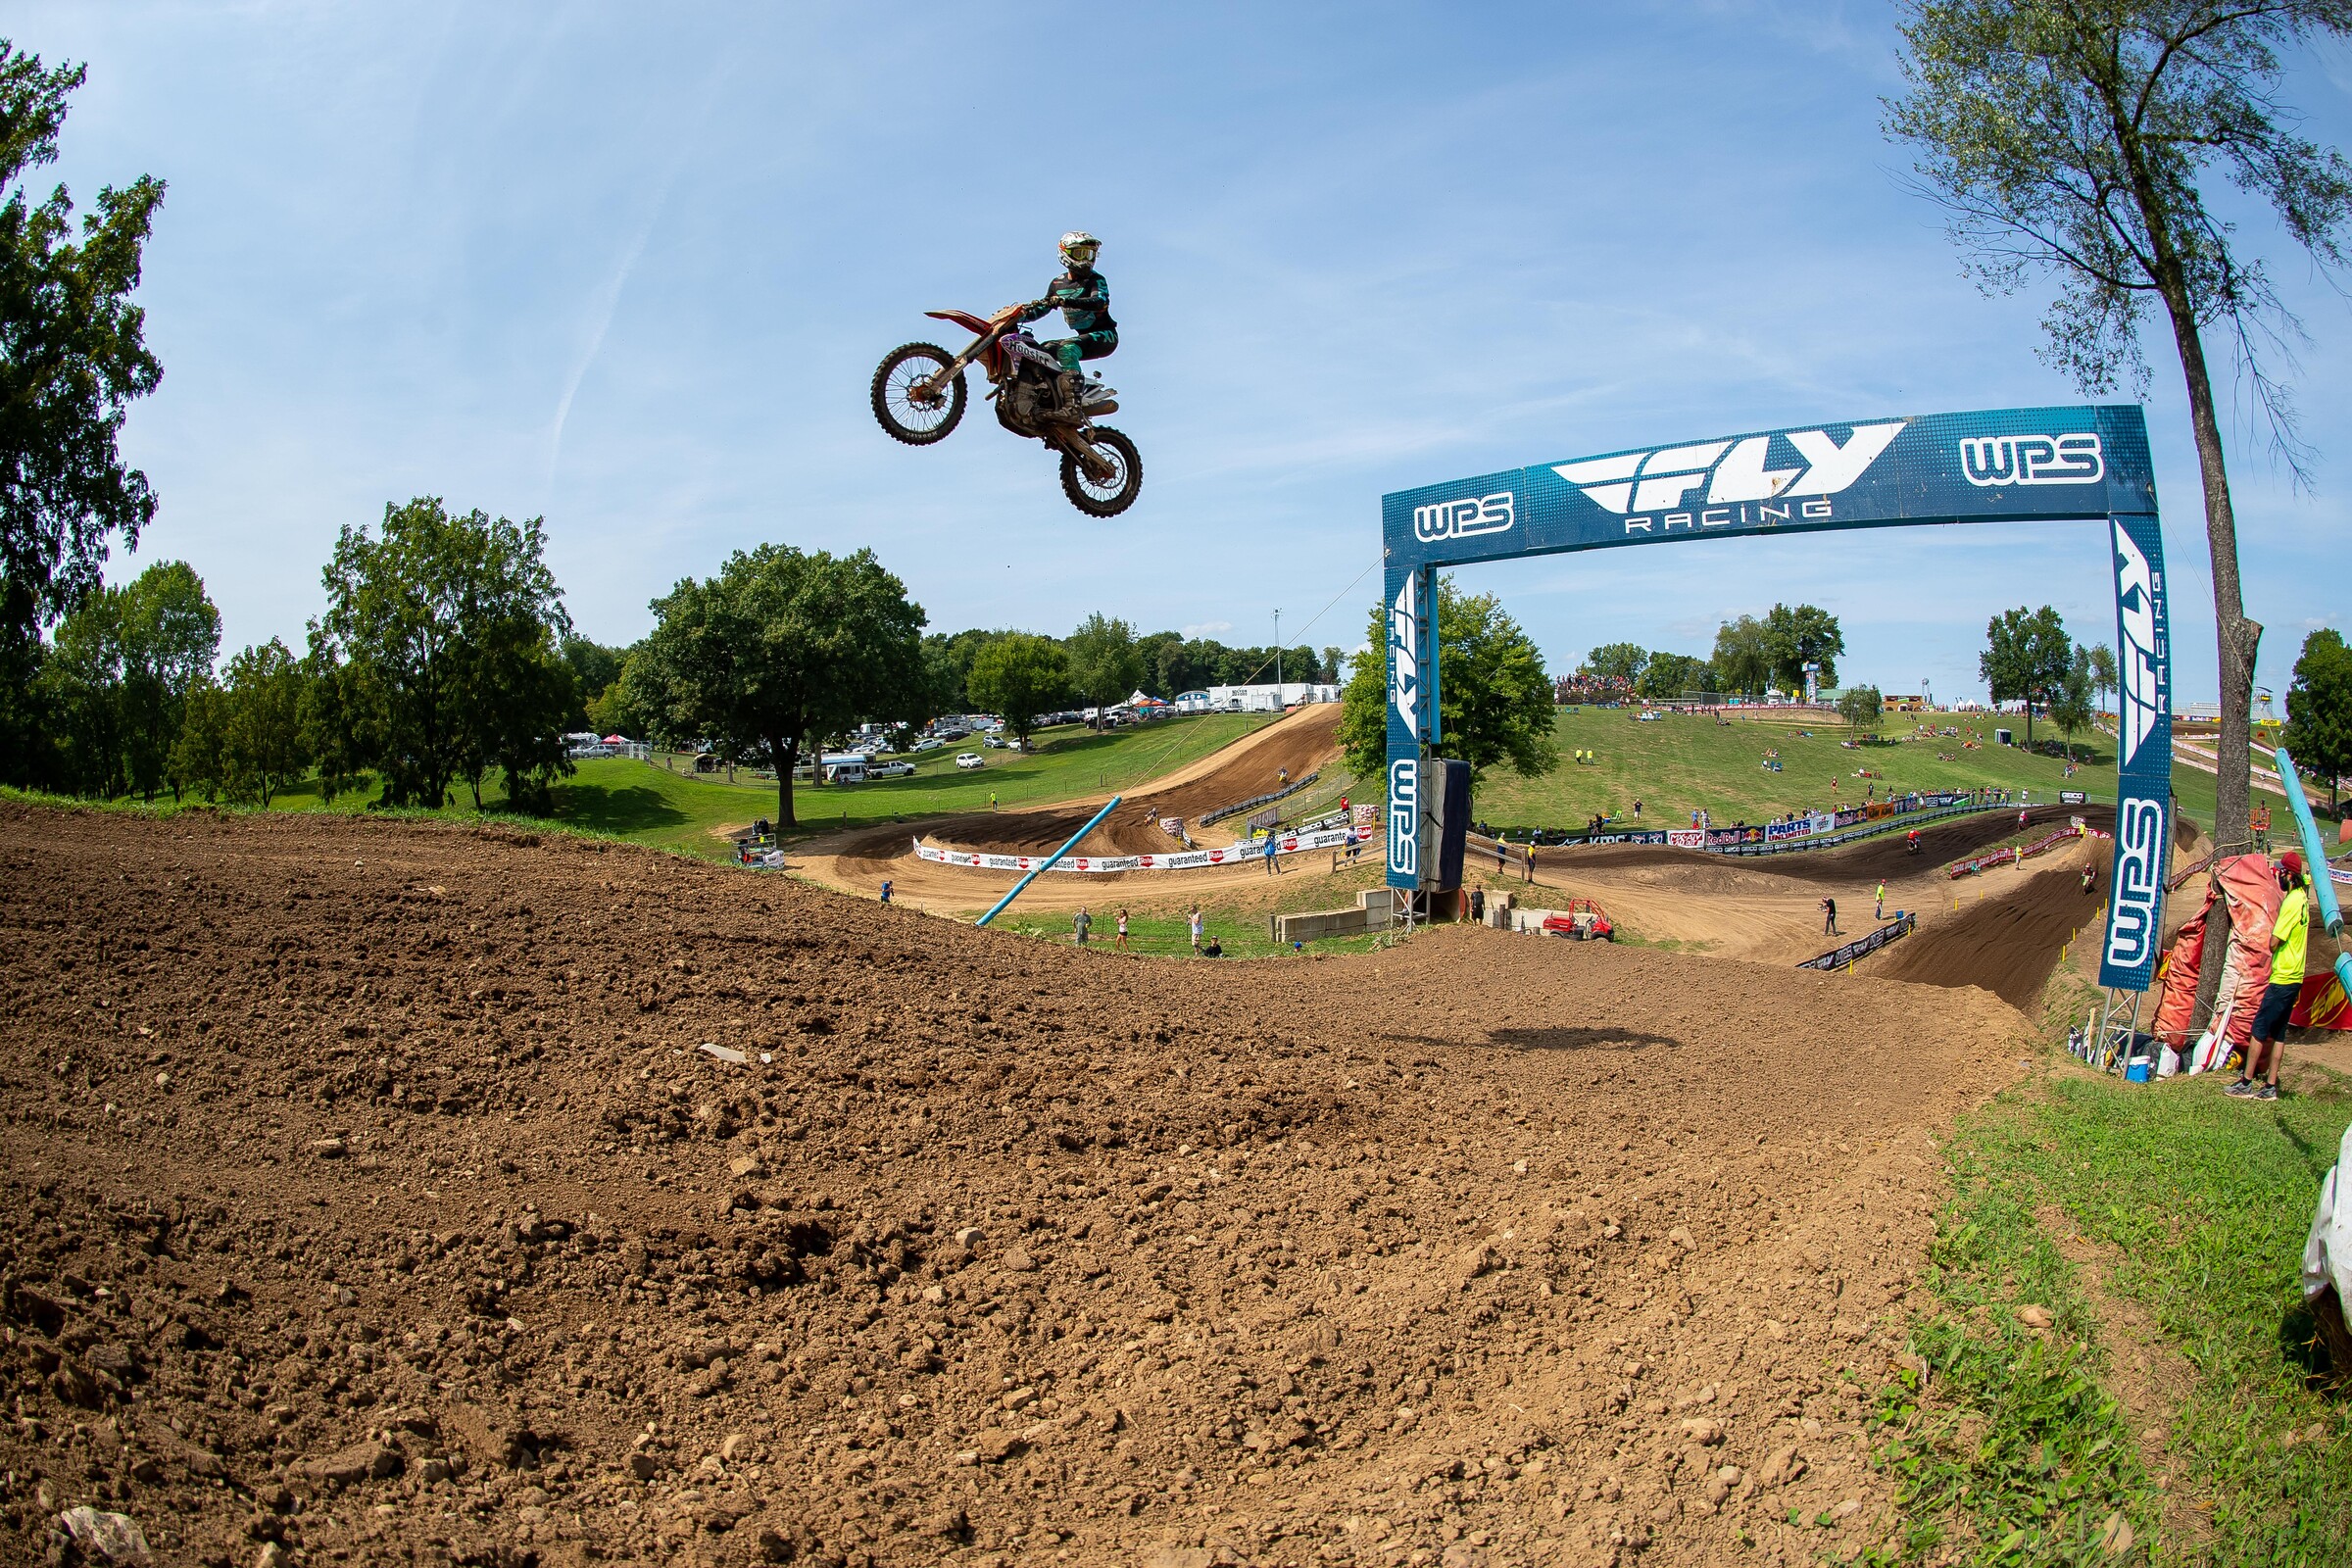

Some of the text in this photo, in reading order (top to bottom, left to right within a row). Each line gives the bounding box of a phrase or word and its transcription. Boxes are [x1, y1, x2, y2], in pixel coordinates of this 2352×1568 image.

[1551, 422, 1908, 514] FLY
[1961, 433, 2105, 486] WPS
[1413, 491, 1514, 543] WPS
[1624, 500, 1833, 532] RACING
[1395, 569, 1417, 739] FLY
[2114, 519, 2156, 766] FLY
[2152, 571, 2166, 714] RACING
[1391, 759, 1417, 875] WPS
[1768, 819, 1810, 835] PARTS
[1768, 828, 1811, 841] UNLIMITED
[1168, 853, 1207, 867] guaranteed
[2107, 798, 2163, 968] WPS
